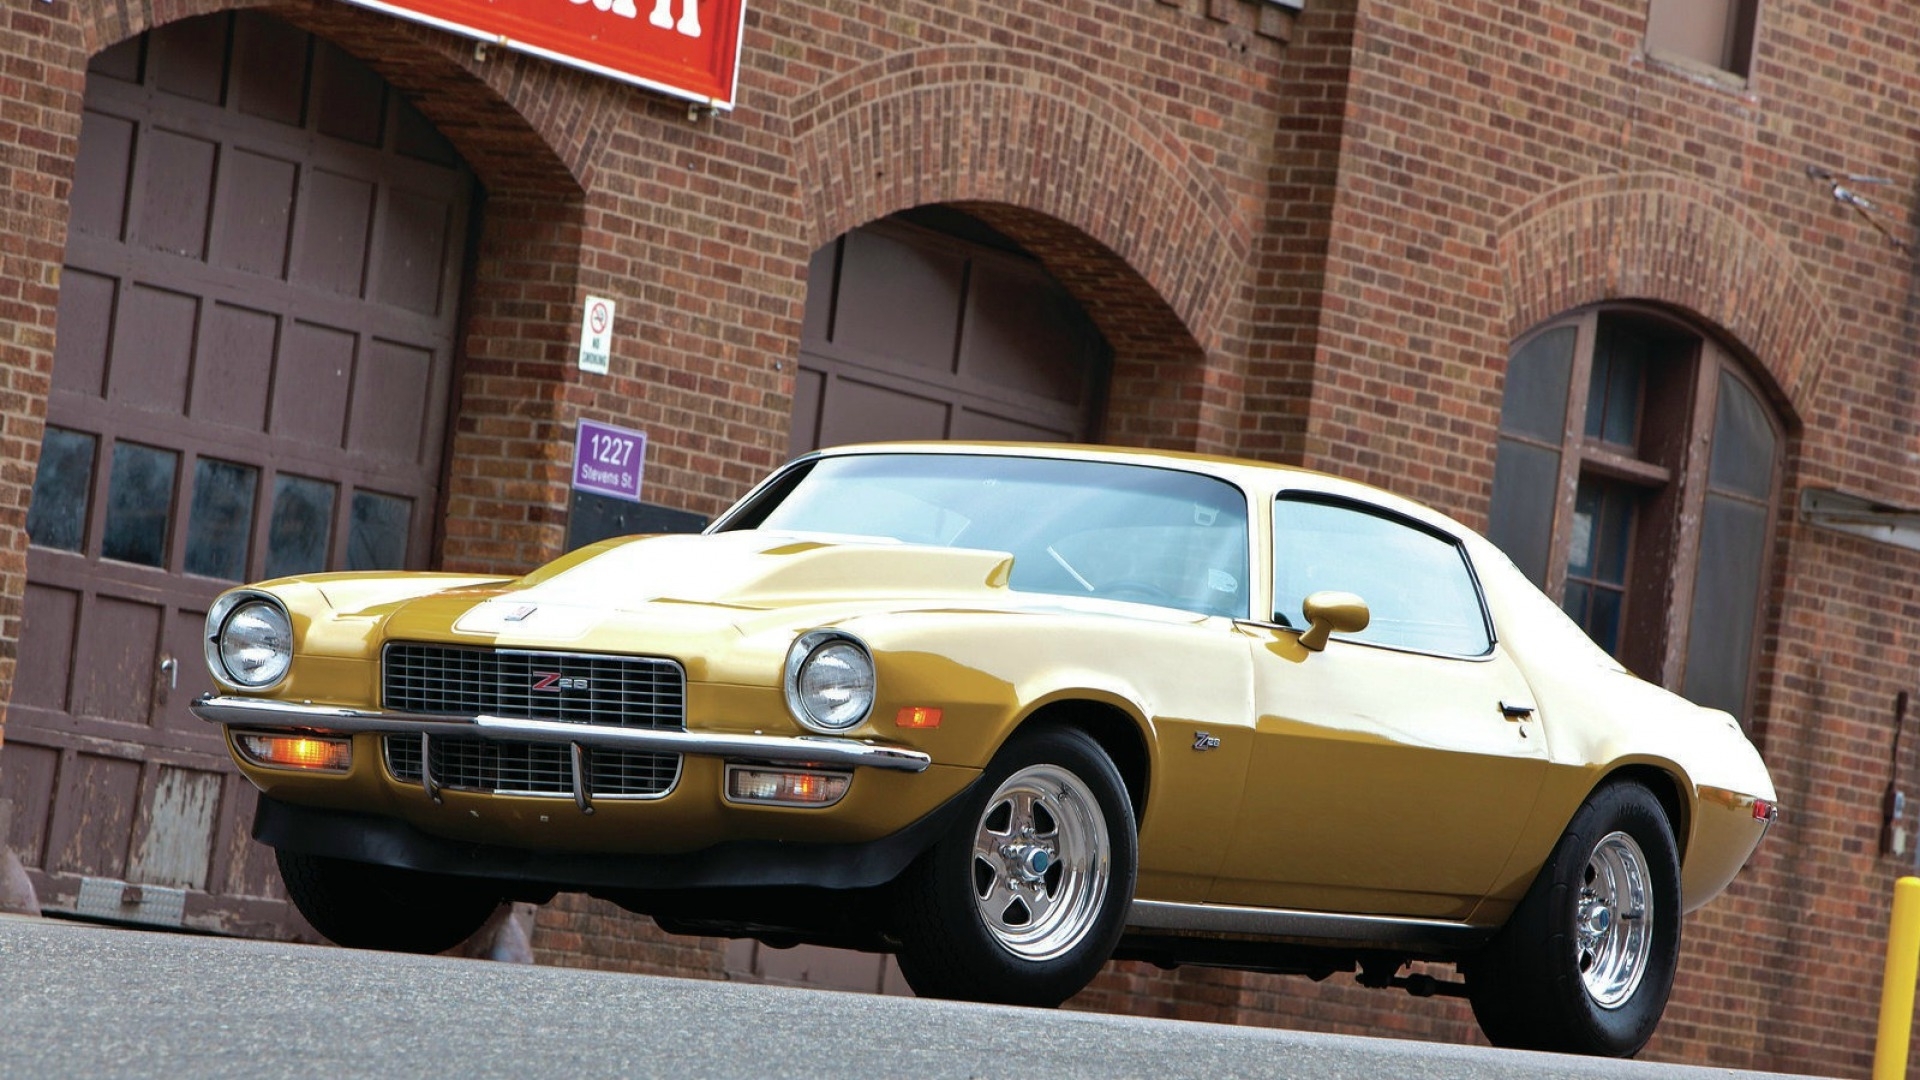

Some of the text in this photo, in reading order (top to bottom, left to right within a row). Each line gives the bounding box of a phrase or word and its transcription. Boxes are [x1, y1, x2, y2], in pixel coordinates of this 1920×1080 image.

[592, 337, 600, 349] NO
[582, 351, 607, 367] SMOKING
[591, 433, 634, 466] 1227
[581, 463, 619, 486] Stevens
[532, 670, 588, 692] Z28
